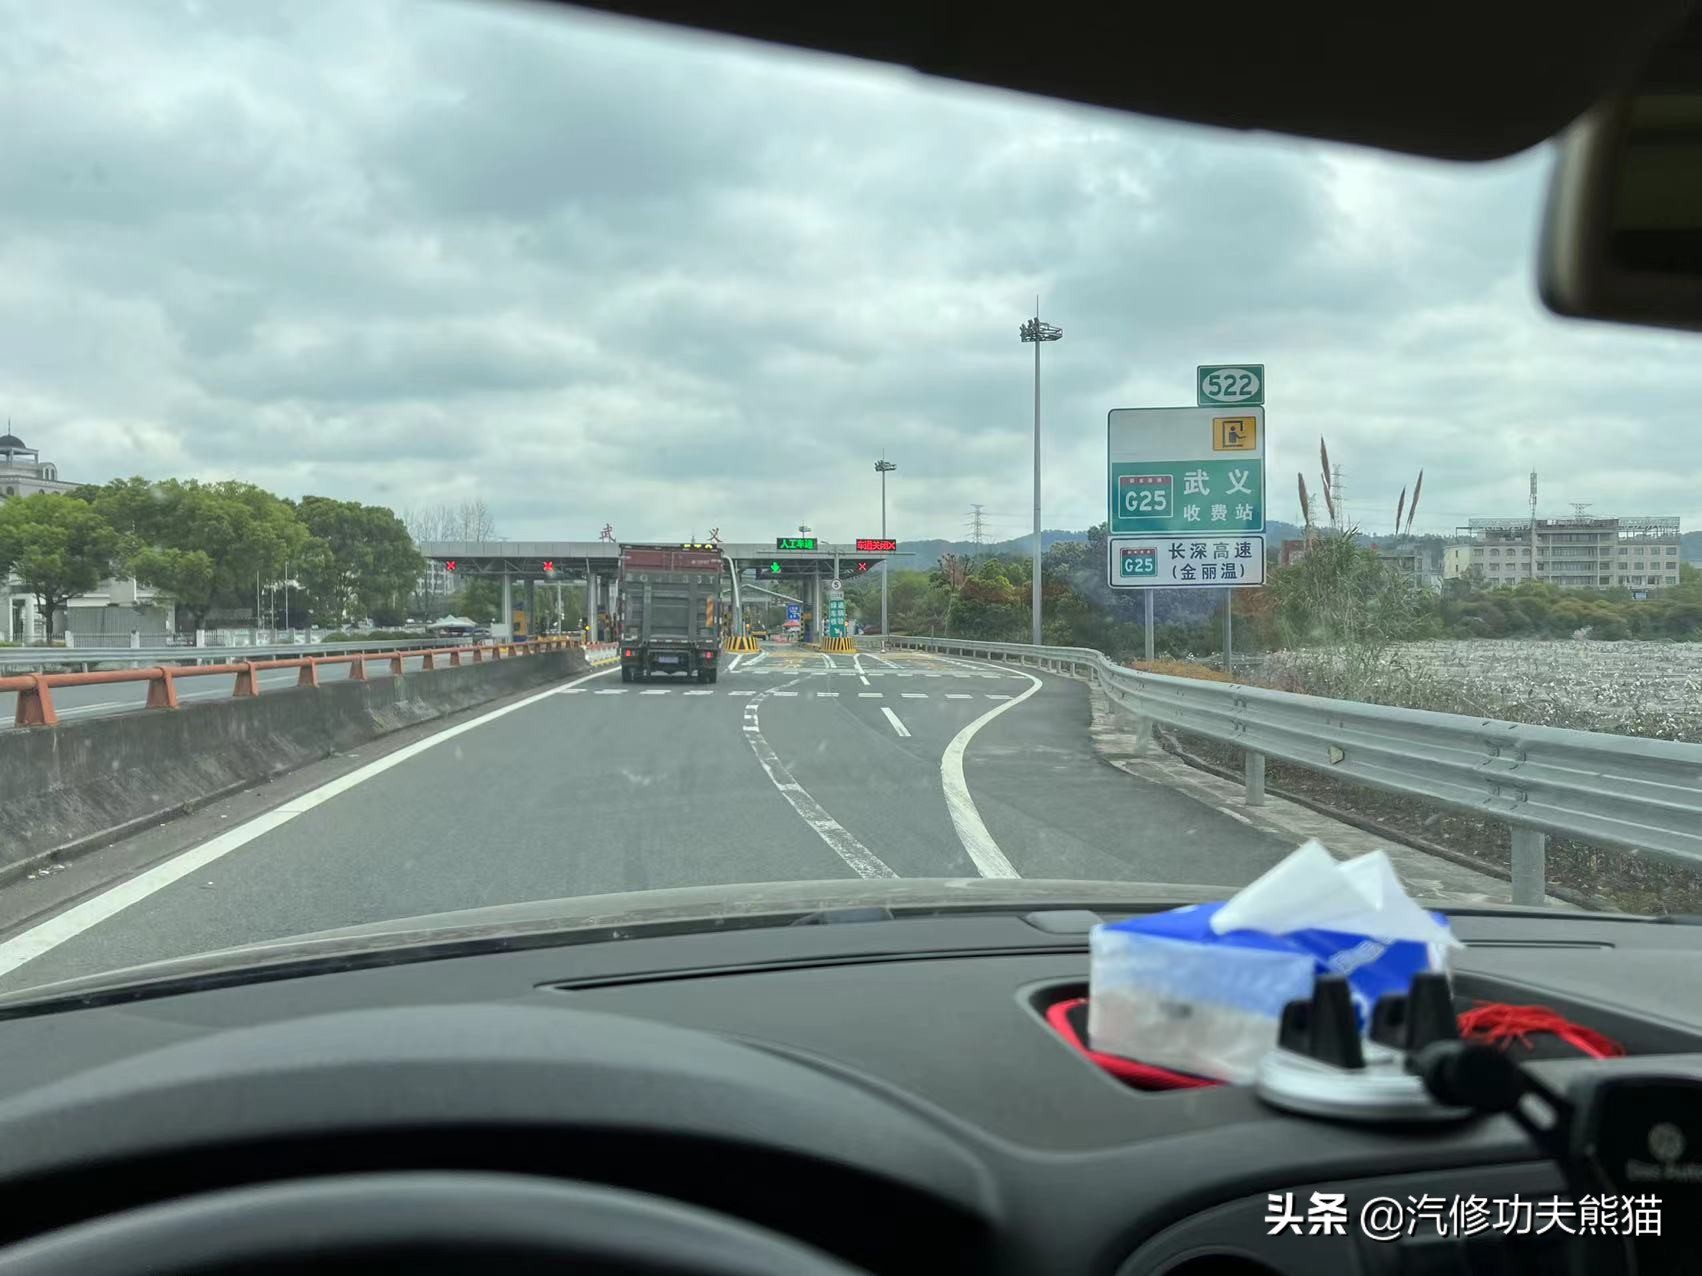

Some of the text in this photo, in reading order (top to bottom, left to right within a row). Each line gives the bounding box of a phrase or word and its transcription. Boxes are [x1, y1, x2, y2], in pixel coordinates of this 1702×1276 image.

[1208, 374, 1253, 396] 522
[1183, 469, 1252, 496] 武义
[1125, 490, 1167, 512] G25
[1183, 503, 1254, 522] 收费站
[1168, 541, 1253, 560] 长深高速
[1124, 557, 1154, 573] G25
[1172, 563, 1245, 580] (金丽温)
